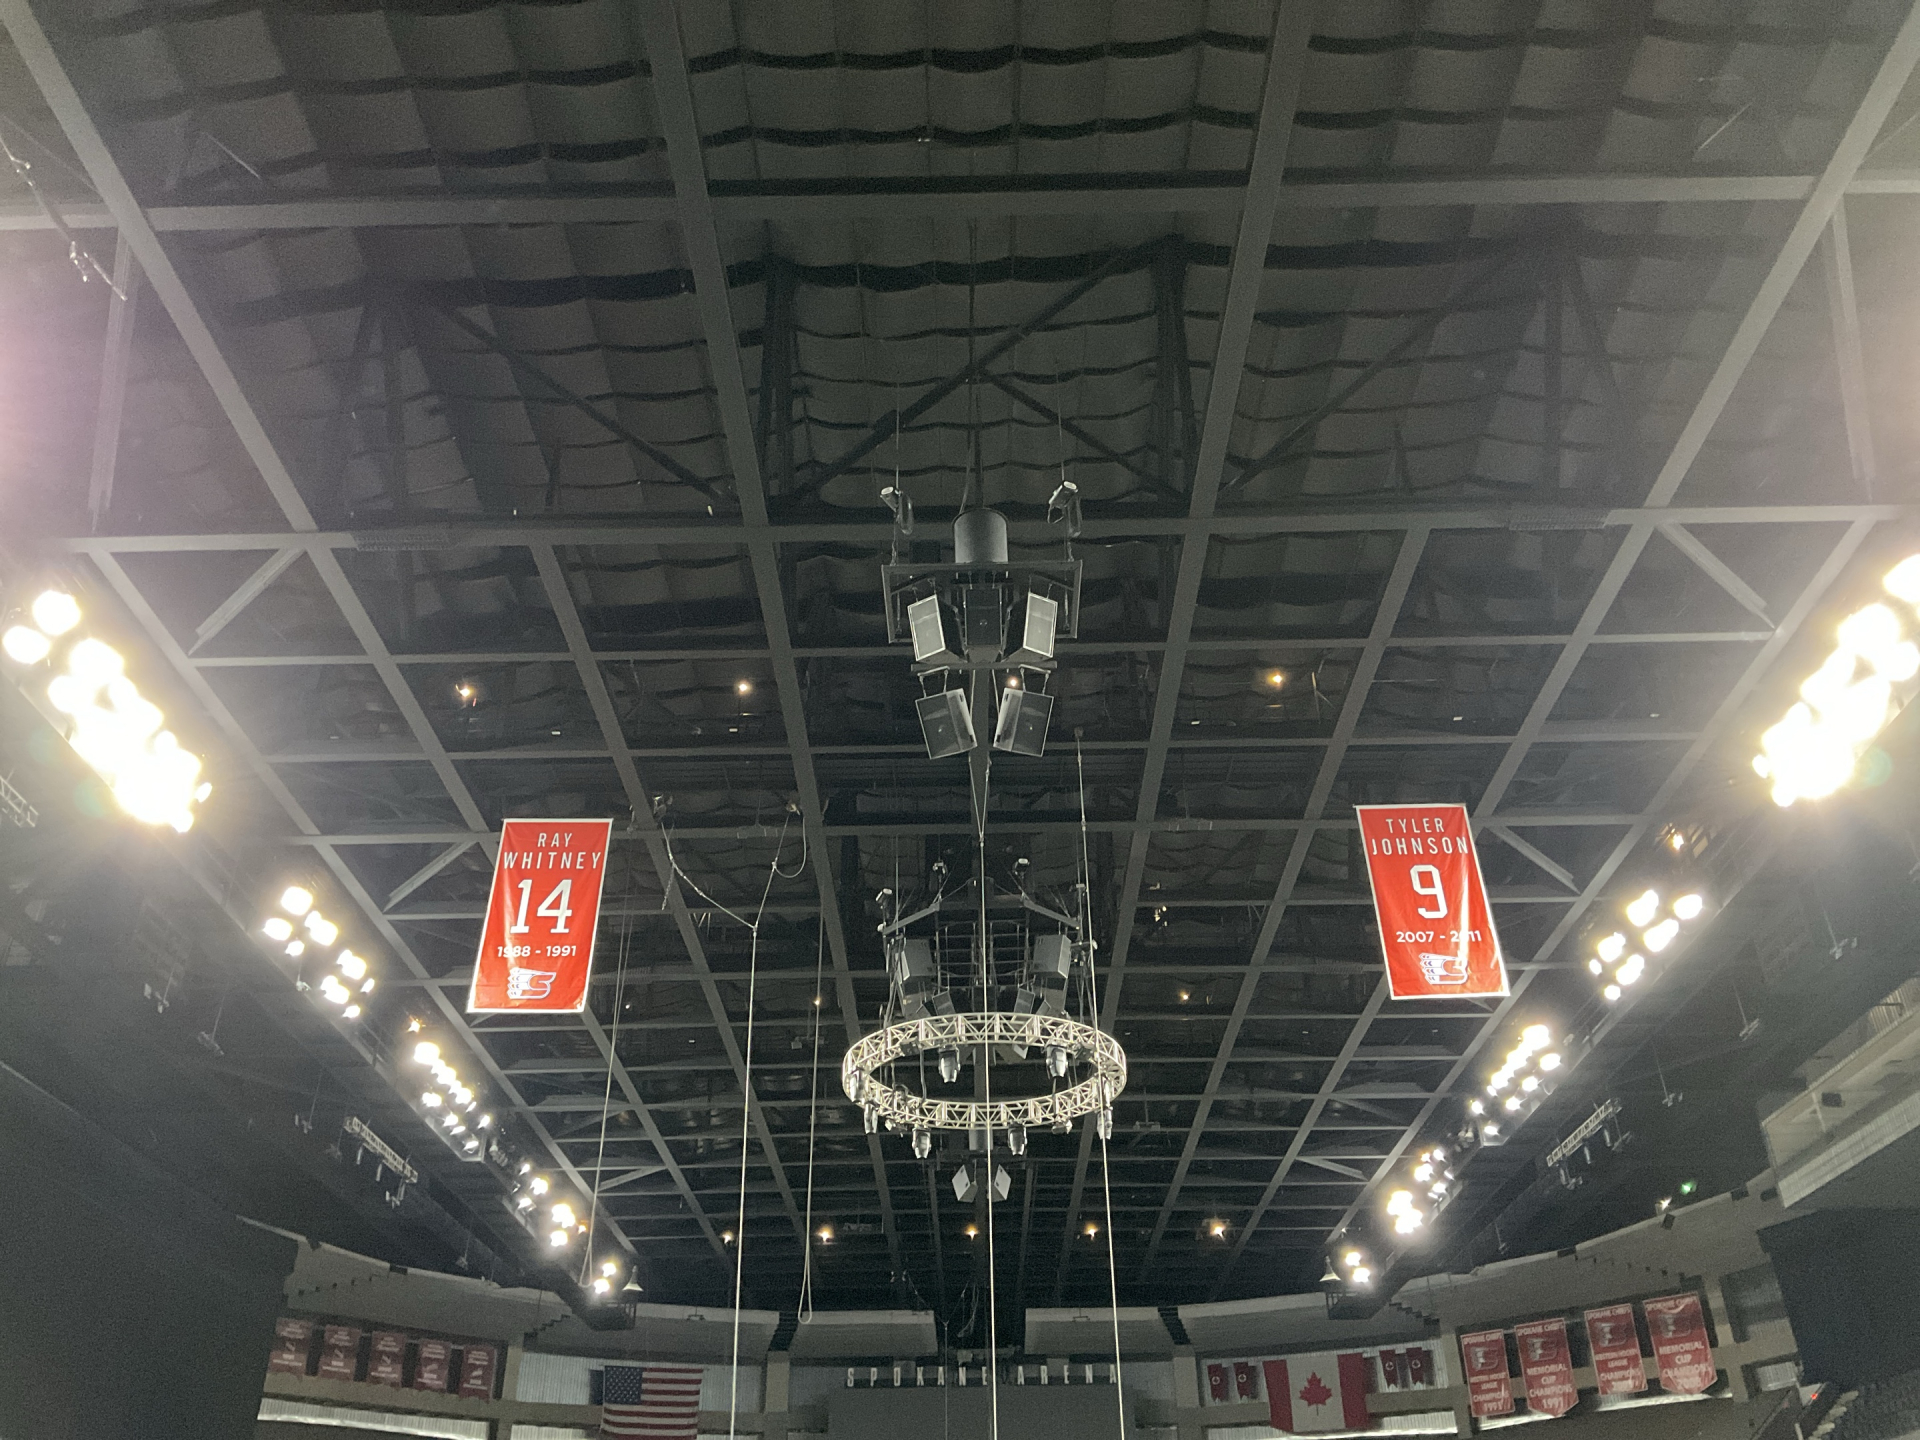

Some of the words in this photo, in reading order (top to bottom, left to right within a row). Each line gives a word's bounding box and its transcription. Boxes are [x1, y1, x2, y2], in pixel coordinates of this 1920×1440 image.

[1386, 817, 1445, 834] TYLER
[537, 832, 573, 848] RAY
[1372, 836, 1469, 856] JOHNSON
[503, 852, 601, 870] WHITNEY
[1410, 864, 1448, 919] 9
[510, 878, 573, 934] 14
[1396, 930, 1435, 943] 2007
[497, 946, 531, 958] 1988
[546, 945, 577, 957] 1991
[1658, 1341, 1704, 1355] MEMORIAL
[1675, 1354, 1692, 1364] CUP
[847, 1366, 988, 1387] SPOKANE
[1017, 1364, 1117, 1385] ARENA
[1526, 1364, 1568, 1376] MEMORIAL
[1541, 1375, 1556, 1384] CUP
[1529, 1384, 1573, 1398] CHAMPIONS
